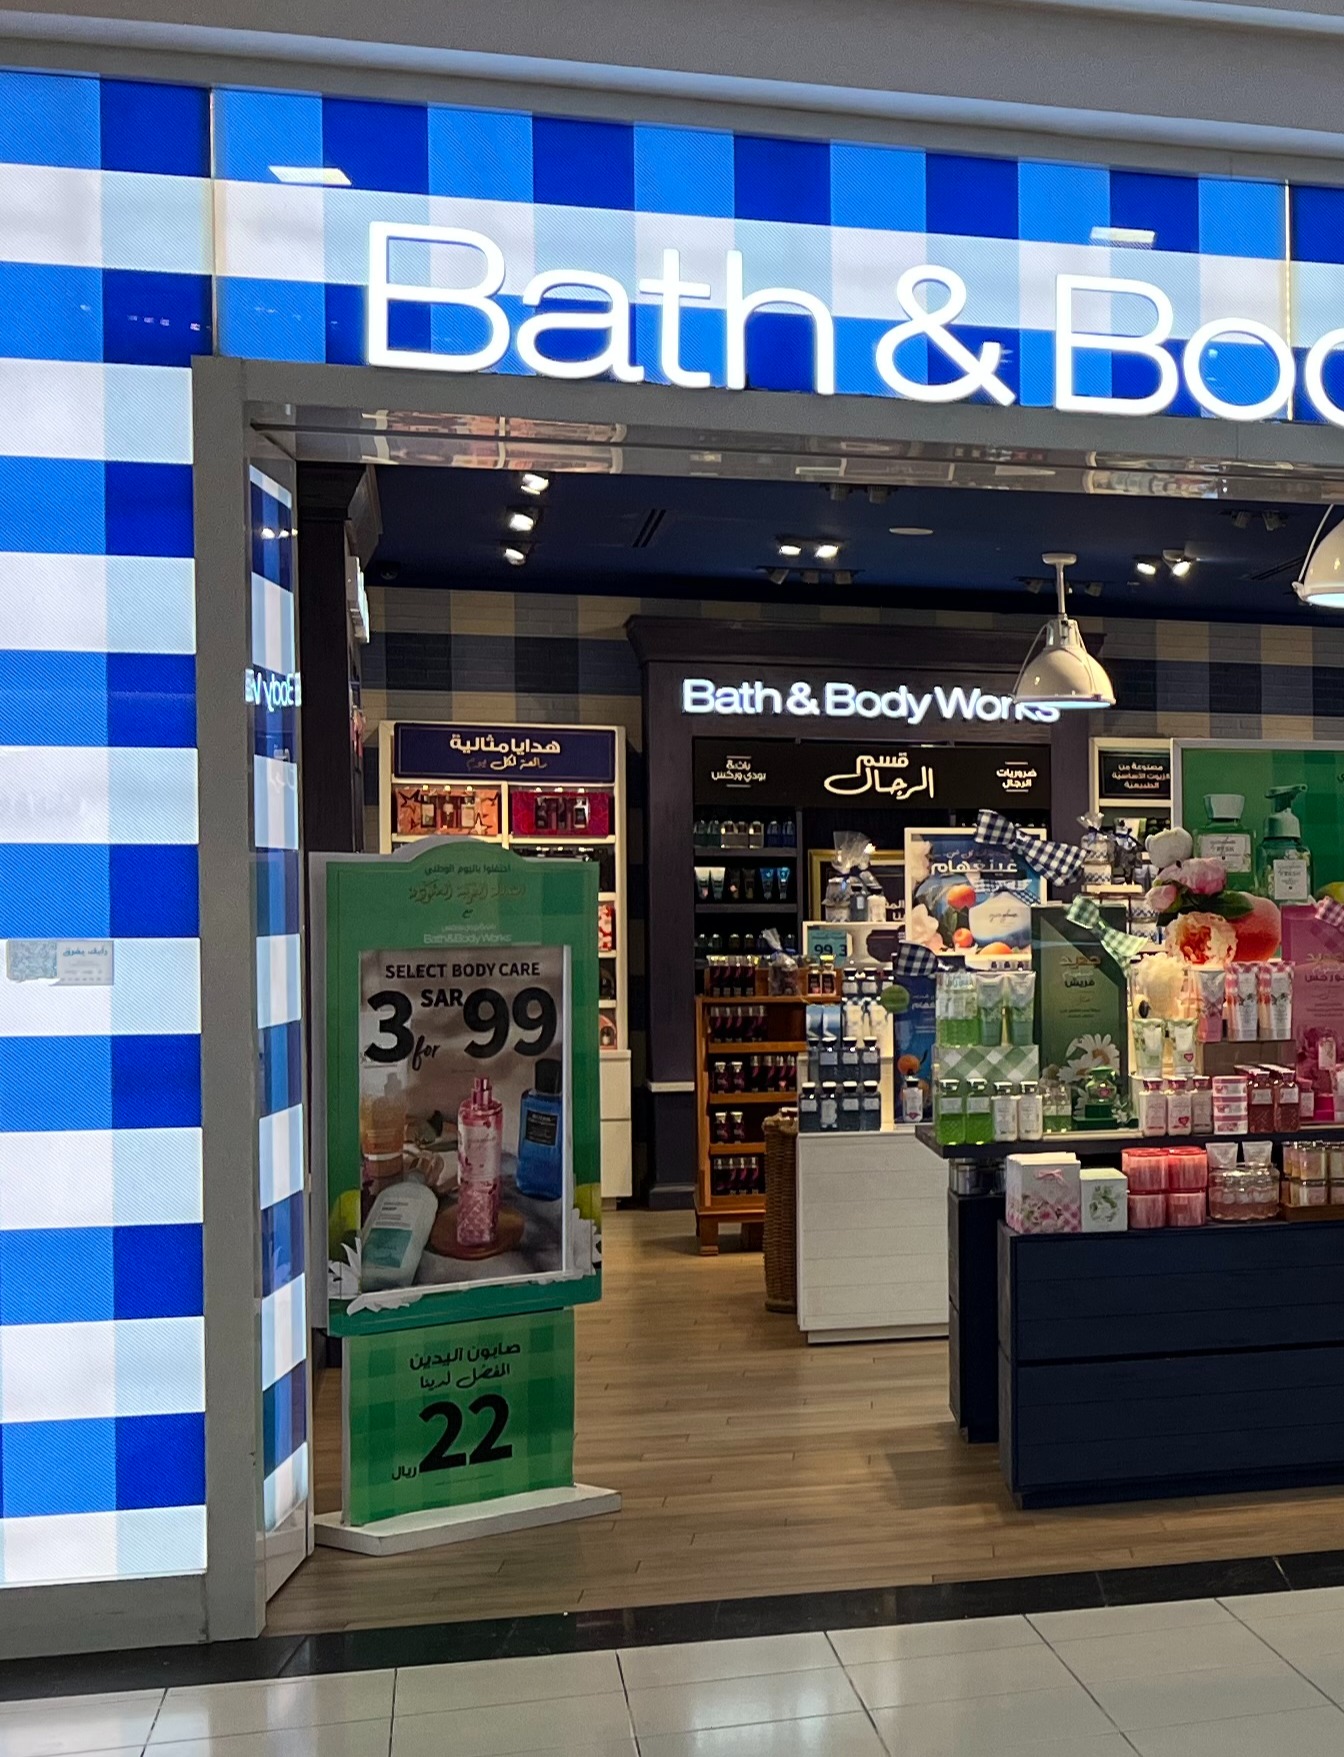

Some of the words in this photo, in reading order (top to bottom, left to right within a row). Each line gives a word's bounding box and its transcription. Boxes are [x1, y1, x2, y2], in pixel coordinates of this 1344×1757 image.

[366, 219, 836, 397] Bath
[874, 264, 1016, 407] &
[682, 678, 781, 715] Bath
[786, 681, 819, 716] &
[825, 682, 932, 726] Body
[933, 685, 1061, 723] Works
[385, 963, 447, 979] SELECT
[452, 962, 496, 978] BODY
[498, 961, 540, 977] CARE
[420, 989, 464, 1008] SAR
[364, 990, 414, 1063] 3
[462, 987, 558, 1060] 99
[412, 1035, 441, 1071] for
[409, 1347, 463, 1371] اليدين
[467, 1342, 521, 1363] صابون
[419, 1370, 451, 1389] لدينا
[455, 1362, 511, 1389] المفضل
[418, 1393, 513, 1474] 22
[391, 1465, 418, 1481] ريال
